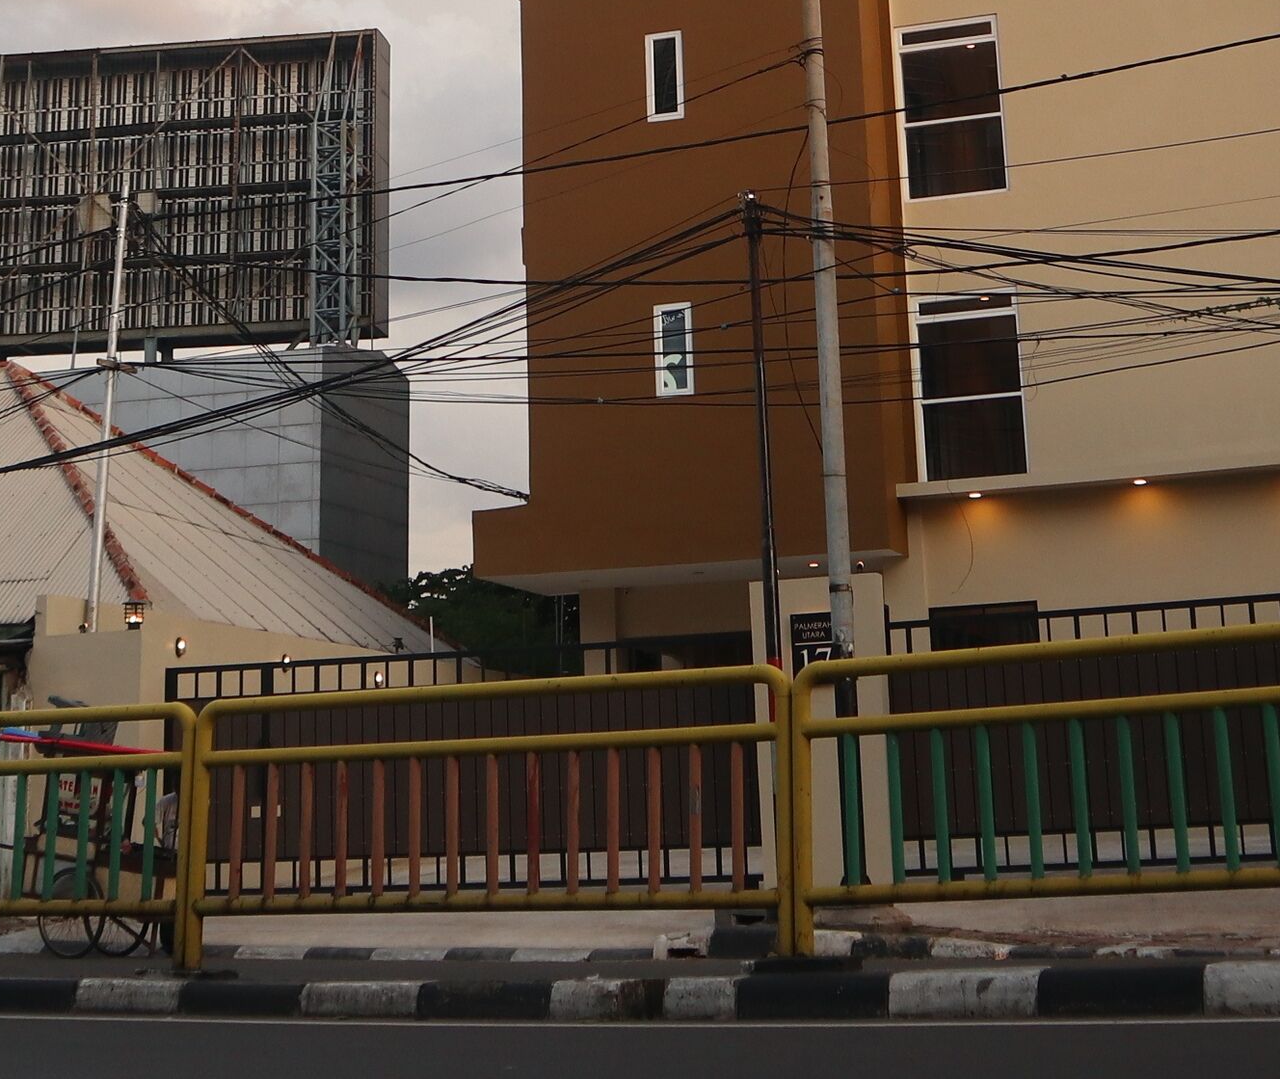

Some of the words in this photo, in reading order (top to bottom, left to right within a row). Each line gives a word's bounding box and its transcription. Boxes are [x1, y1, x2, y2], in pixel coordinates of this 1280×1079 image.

[794, 622, 832, 630] PALMERAH
[802, 631, 825, 639] UTARA
[800, 648, 831, 667] 17
